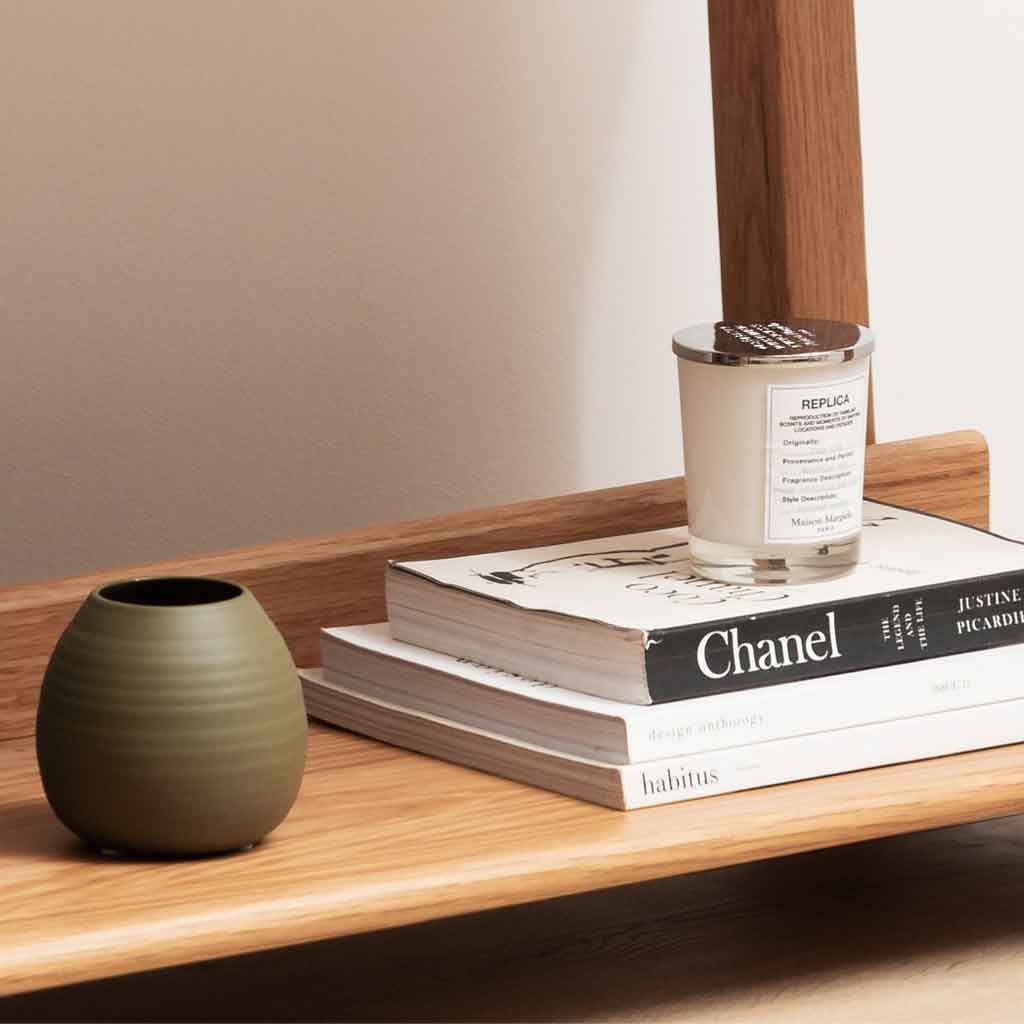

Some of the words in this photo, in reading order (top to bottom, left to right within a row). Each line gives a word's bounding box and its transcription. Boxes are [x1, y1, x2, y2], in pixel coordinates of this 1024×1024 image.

[801, 394, 849, 409] REPLICA
[958, 588, 1022, 613] JUSTINE
[882, 617, 891, 641] THE
[893, 604, 905, 651] LEGEND
[904, 612, 915, 638] AND
[916, 623, 928, 650] THE
[696, 611, 842, 679] Chanel
[641, 766, 719, 796] habitus
